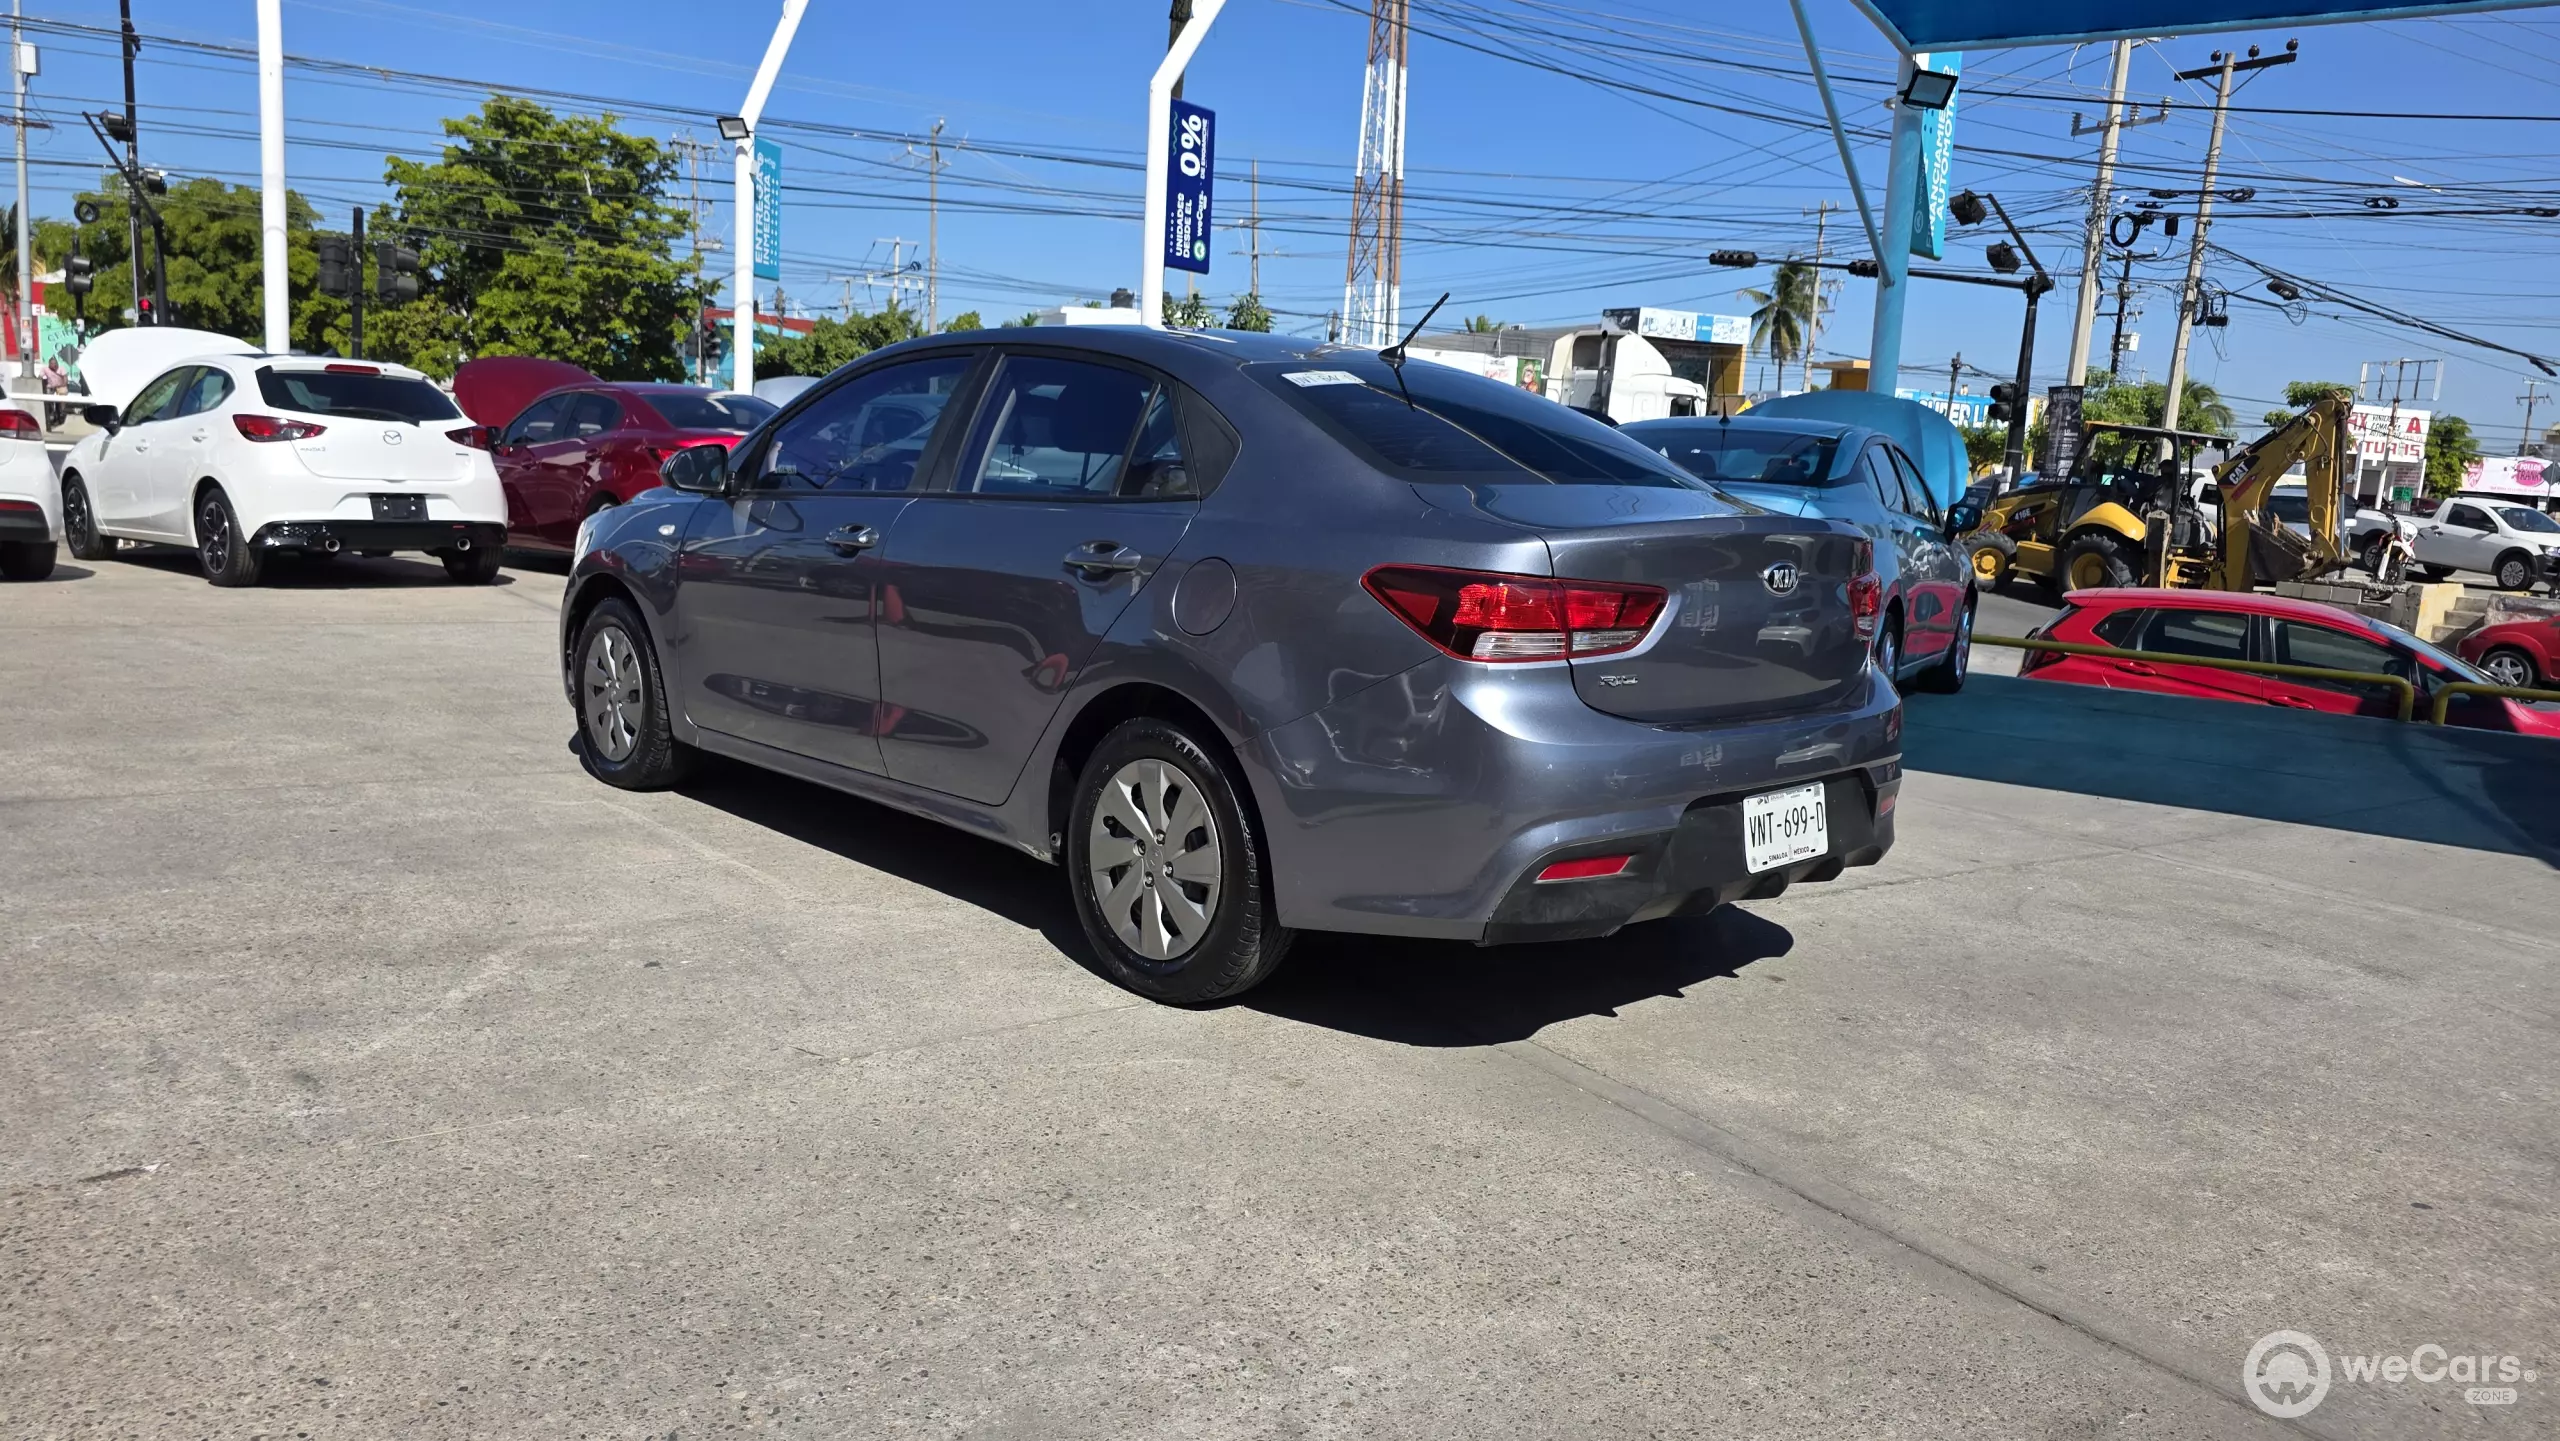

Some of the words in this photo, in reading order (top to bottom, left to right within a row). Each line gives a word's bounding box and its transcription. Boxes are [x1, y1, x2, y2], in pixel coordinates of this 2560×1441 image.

[1180, 114, 1202, 177] 0%
[1926, 65, 1949, 248] FINANCIAMIEO
[1936, 67, 1958, 221] AUTOMOTRZ
[755, 171, 764, 263] ENTREGA
[763, 174, 771, 265] INMEDIATA
[1176, 192, 1185, 257] UNIDADES
[1183, 216, 1192, 258] DESDE
[1185, 199, 1192, 215] EL
[2228, 460, 2249, 485] CAT
[1749, 801, 1824, 848] VNT-699-D
[1768, 851, 1788, 862] SINALOA
